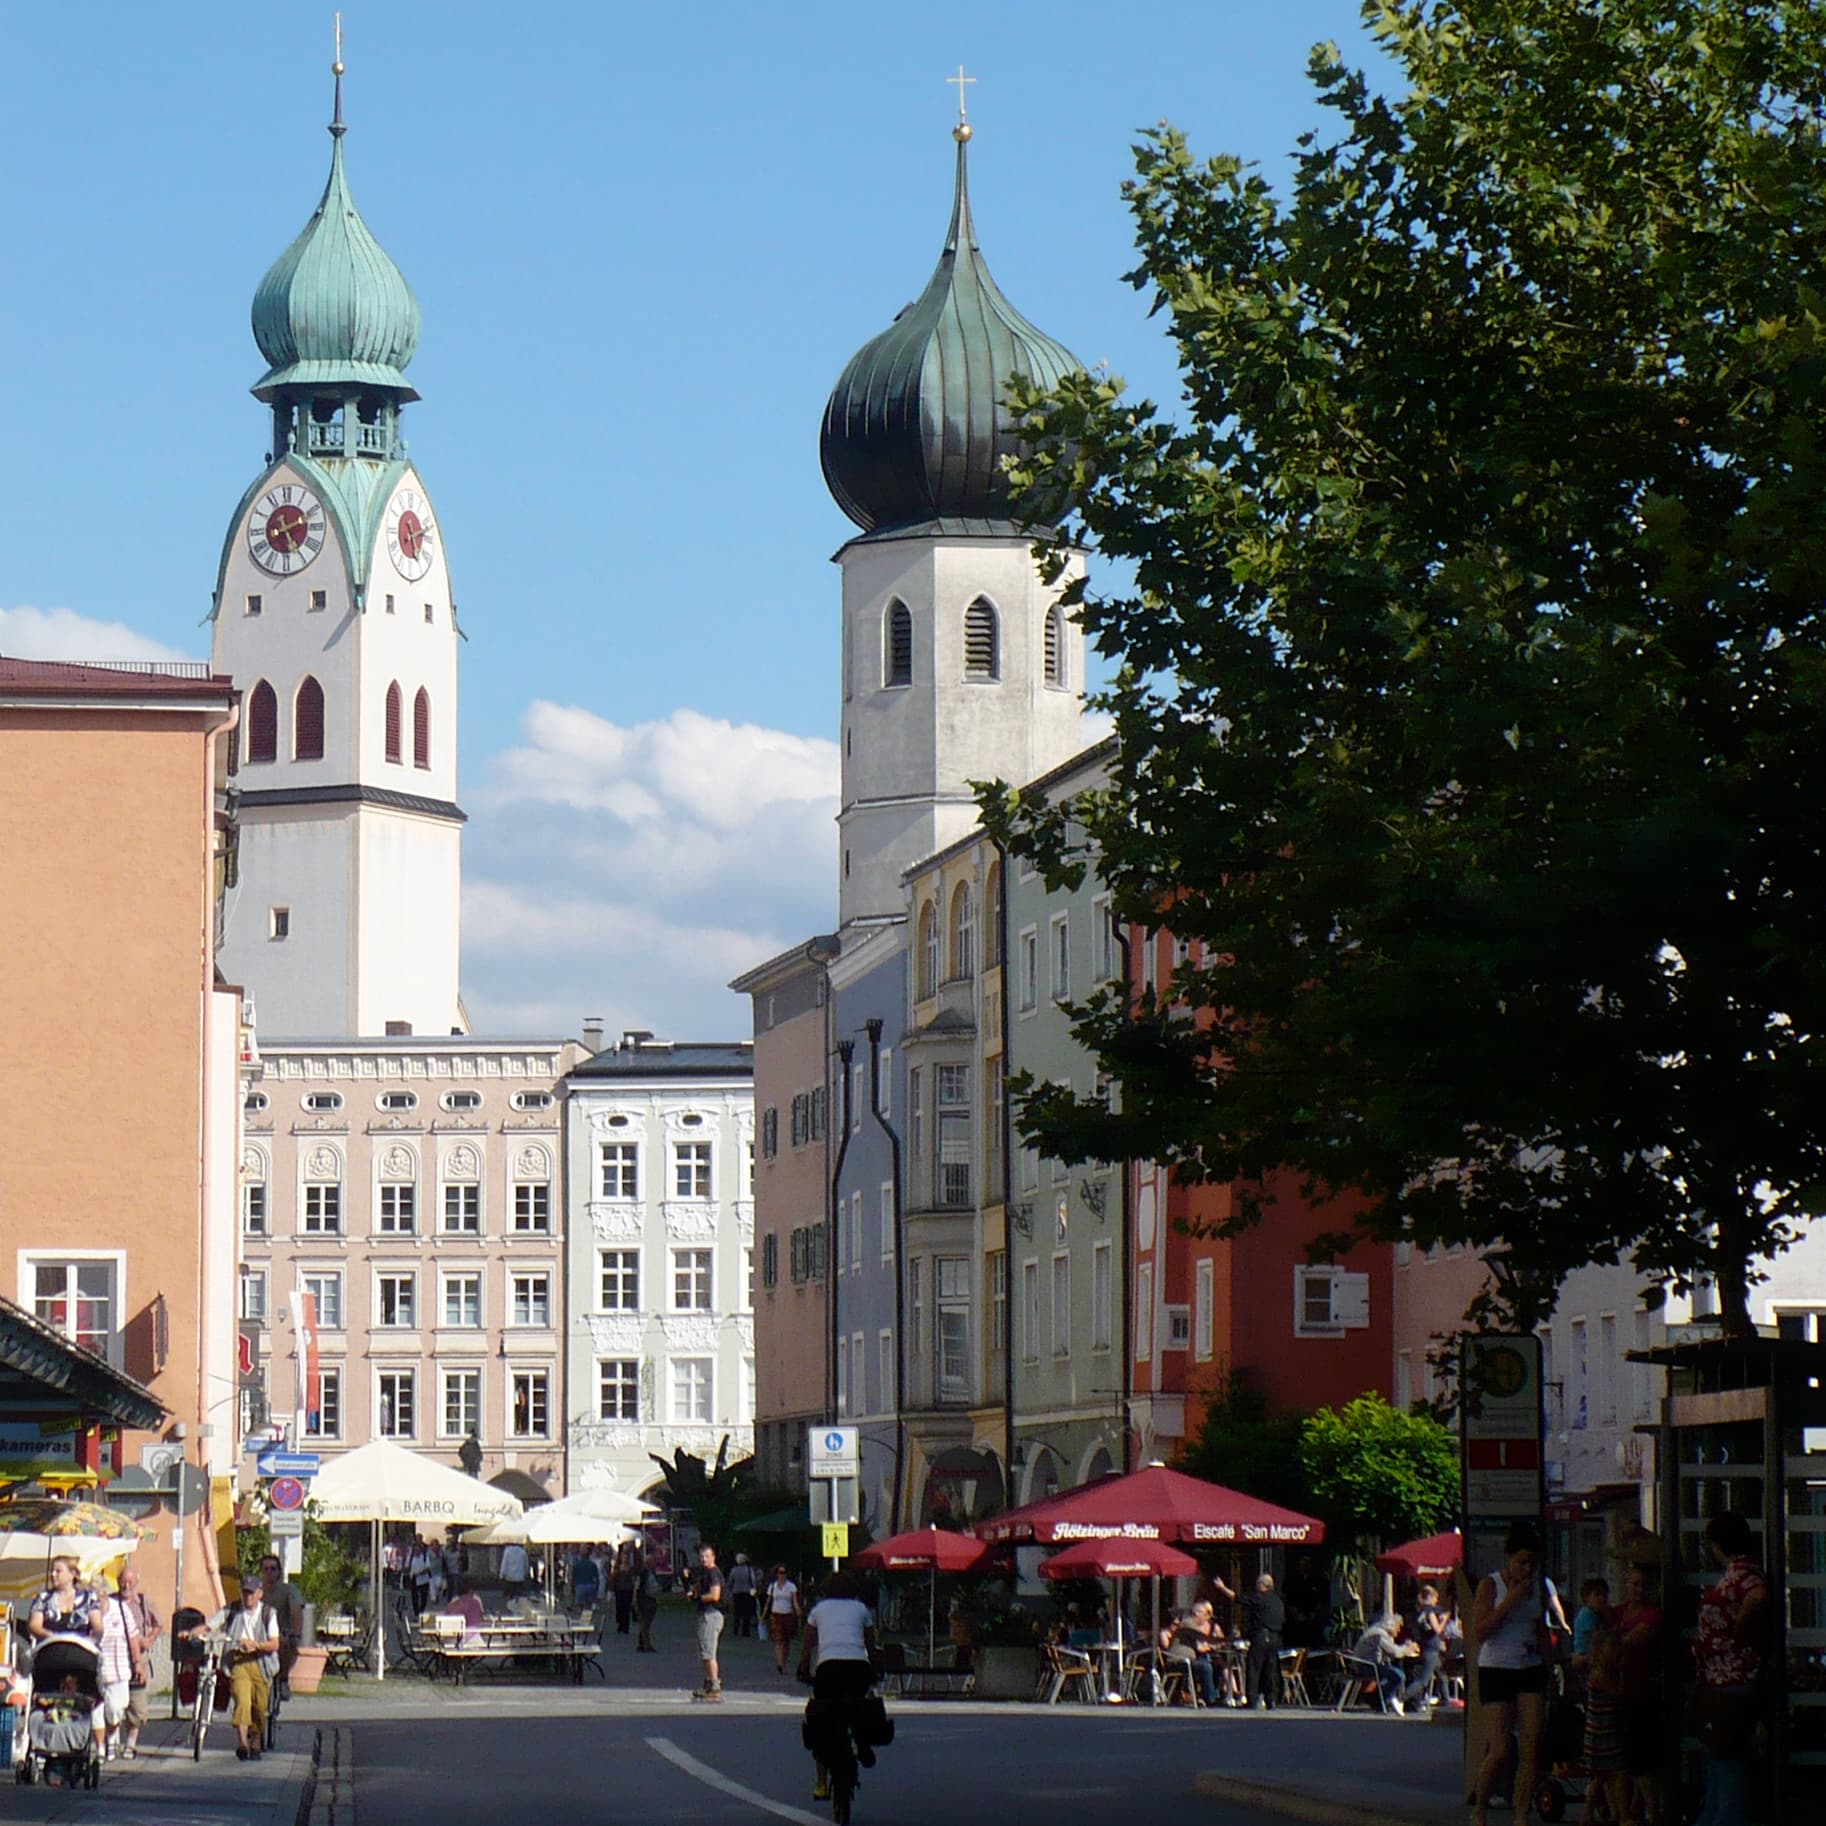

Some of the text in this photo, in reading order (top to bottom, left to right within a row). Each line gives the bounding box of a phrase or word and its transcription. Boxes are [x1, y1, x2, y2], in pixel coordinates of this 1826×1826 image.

[403, 1500, 455, 1514] BARBQ
[1052, 1522, 1121, 1540] Flötzinger
[1122, 1522, 1160, 1538] Bräu
[1193, 1523, 1235, 1539] Eiscafé
